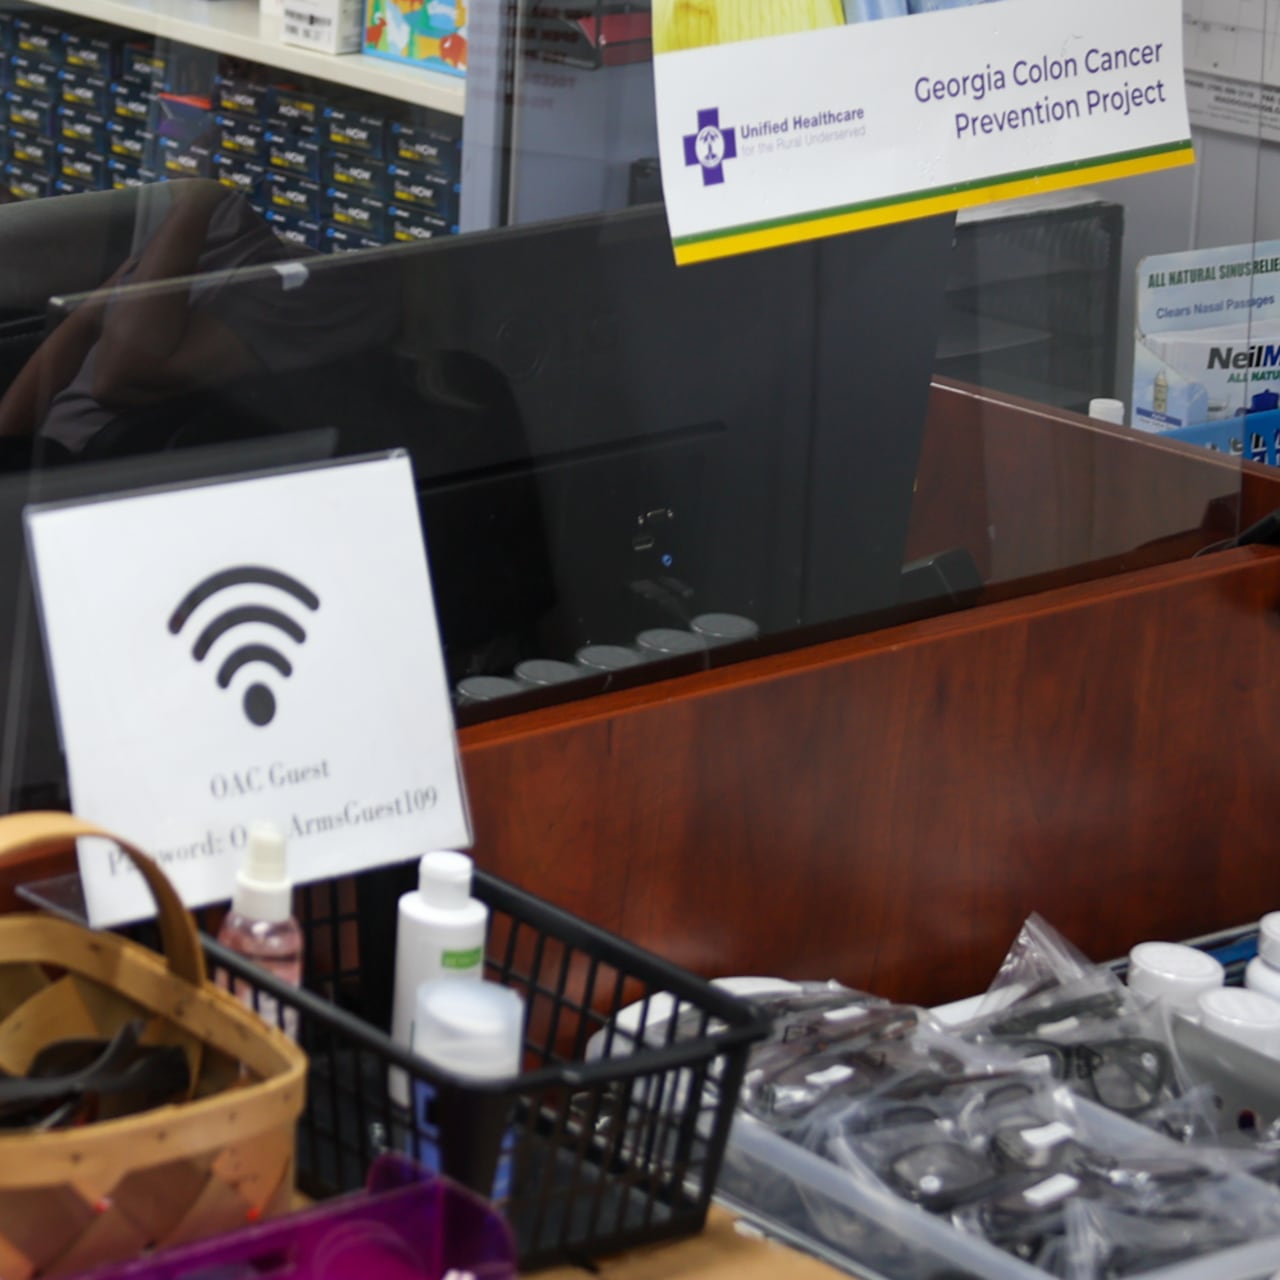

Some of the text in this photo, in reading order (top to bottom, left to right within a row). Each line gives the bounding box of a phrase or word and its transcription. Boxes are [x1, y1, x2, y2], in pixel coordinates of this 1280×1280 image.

[914, 43, 1163, 103] Georgia Colon Cancer
[740, 107, 865, 140] Unified Healthcare
[954, 96, 1080, 140] Prevention
[1086, 79, 1167, 116] Project
[741, 125, 867, 156] for the Rural Underserved
[1148, 272, 1166, 289] ALL
[1169, 265, 1216, 287] NATURAL
[1219, 261, 1252, 279] SINUS
[1156, 294, 1275, 320] Clears Nasal Passages
[1227, 372, 1248, 383] ALL
[210, 758, 330, 800] OAC Guest
